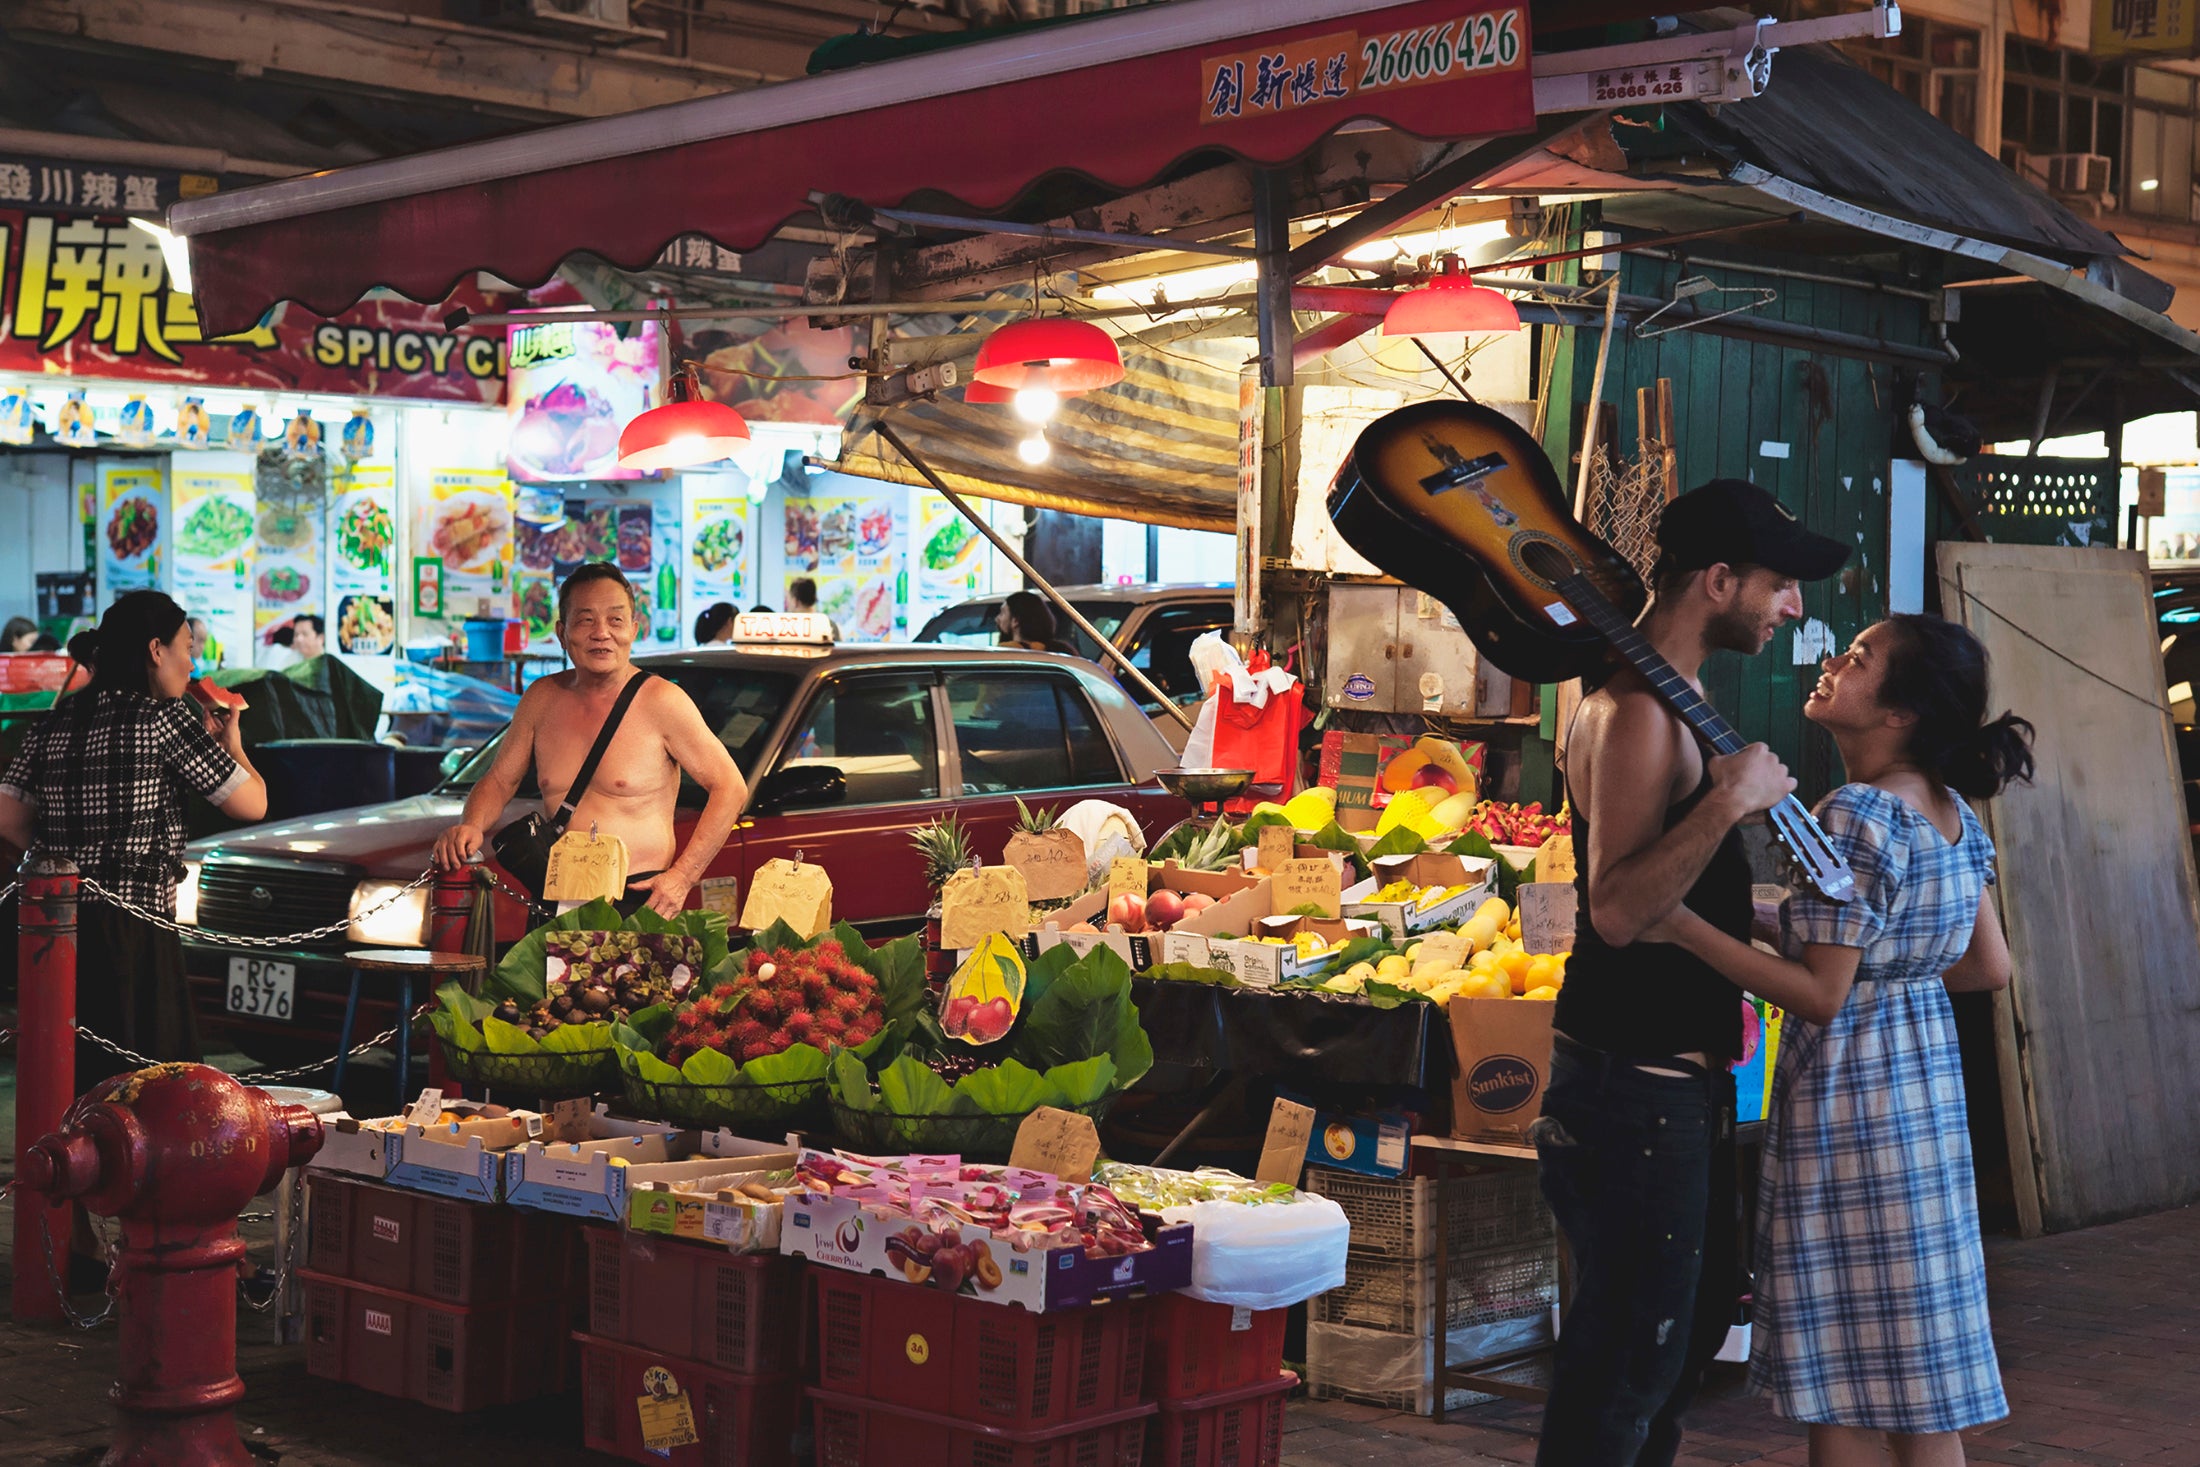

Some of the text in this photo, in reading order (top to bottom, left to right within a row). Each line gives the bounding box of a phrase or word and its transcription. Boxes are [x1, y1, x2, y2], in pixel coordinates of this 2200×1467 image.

[1596, 82, 1683, 100] 26666 426
[316, 326, 454, 373] SPICY
[741, 616, 811, 637] TAXI
[247, 961, 276, 988] RC
[230, 985, 290, 1017] 8376
[1470, 1066, 1532, 1099] Sunkist
[910, 1342, 924, 1355] 3A
